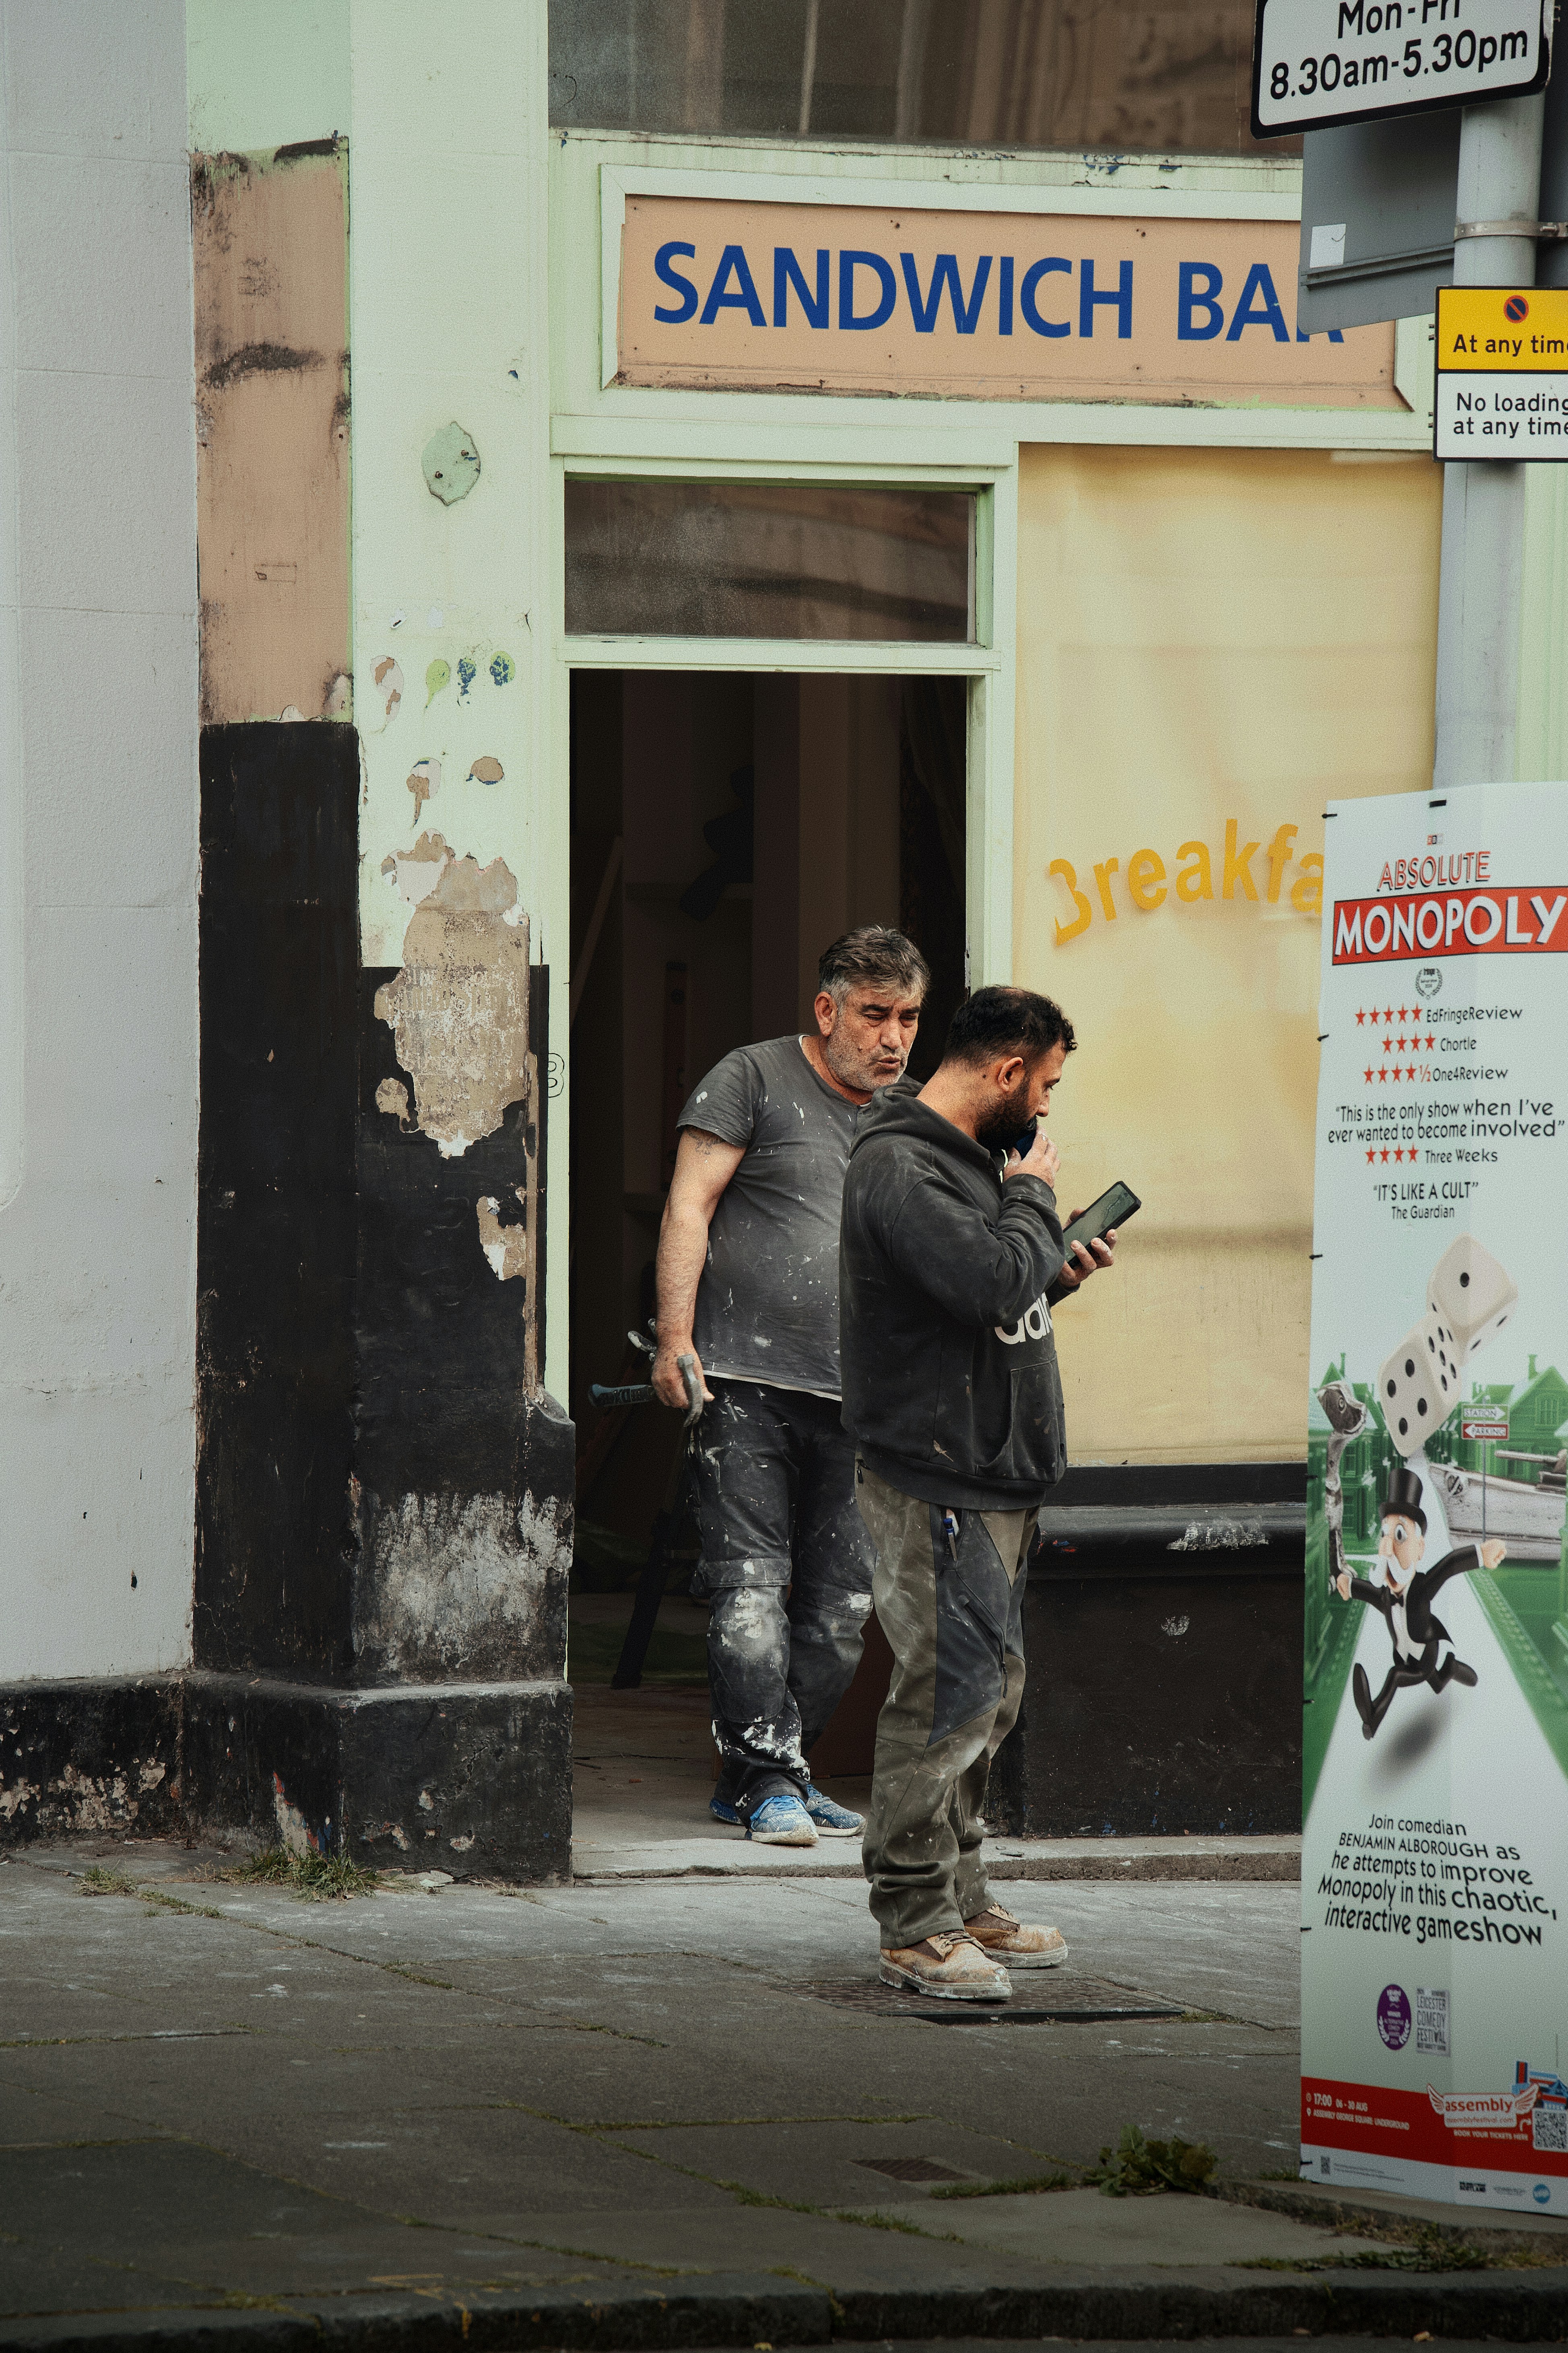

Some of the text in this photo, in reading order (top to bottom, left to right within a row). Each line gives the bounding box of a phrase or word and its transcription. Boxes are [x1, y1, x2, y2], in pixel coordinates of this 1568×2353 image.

[654, 242, 1344, 343] SANDWICH BA
[1453, 335, 1568, 357] At any tim
[1458, 393, 1486, 411] No
[1453, 418, 1474, 435] at
[1482, 420, 1518, 438] any
[1377, 850, 1491, 892] ABSOLUTE
[1335, 895, 1567, 957] MONOPOLY
[1427, 1006, 1523, 1024] EdFringeReview
[1440, 1037, 1476, 1051] Chortle
[1433, 1066, 1508, 1082] One4Review
[1366, 1105, 1374, 1121] is
[1377, 1104, 1395, 1120] the
[1400, 1102, 1424, 1122] only
[1428, 1101, 1459, 1118] show
[1464, 1100, 1510, 1116] when
[1519, 1099, 1554, 1115] I've
[1328, 1127, 1353, 1143] ever
[1357, 1124, 1398, 1141] wanted
[1402, 1125, 1414, 1139] to
[1418, 1122, 1467, 1139] become
[1425, 1149, 1498, 1163] Three Weeks
[1401, 1183, 1424, 1200] LIKE
[1428, 1183, 1438, 1199] A
[1392, 1205, 1455, 1219] The Guardian
[1369, 1814, 1467, 1836] Join comedian
[1339, 1833, 1520, 1860] BENJAMIN ALBOROUGH as
[1332, 1851, 1533, 1885] he attempts to improve
[1318, 1874, 1557, 1920] Monopoly in this chaotic,
[1325, 1902, 1542, 1946] interactive gameshow
[1417, 1996, 1446, 2010] LEICESTER
[1417, 2010, 1446, 2028] COMEDY
[1417, 2027, 1446, 2043] FESTIVAL
[1314, 2093, 1332, 2107] 17:00
[1355, 2102, 1368, 2112] AUG
[1446, 2098, 1512, 2113] assembly
